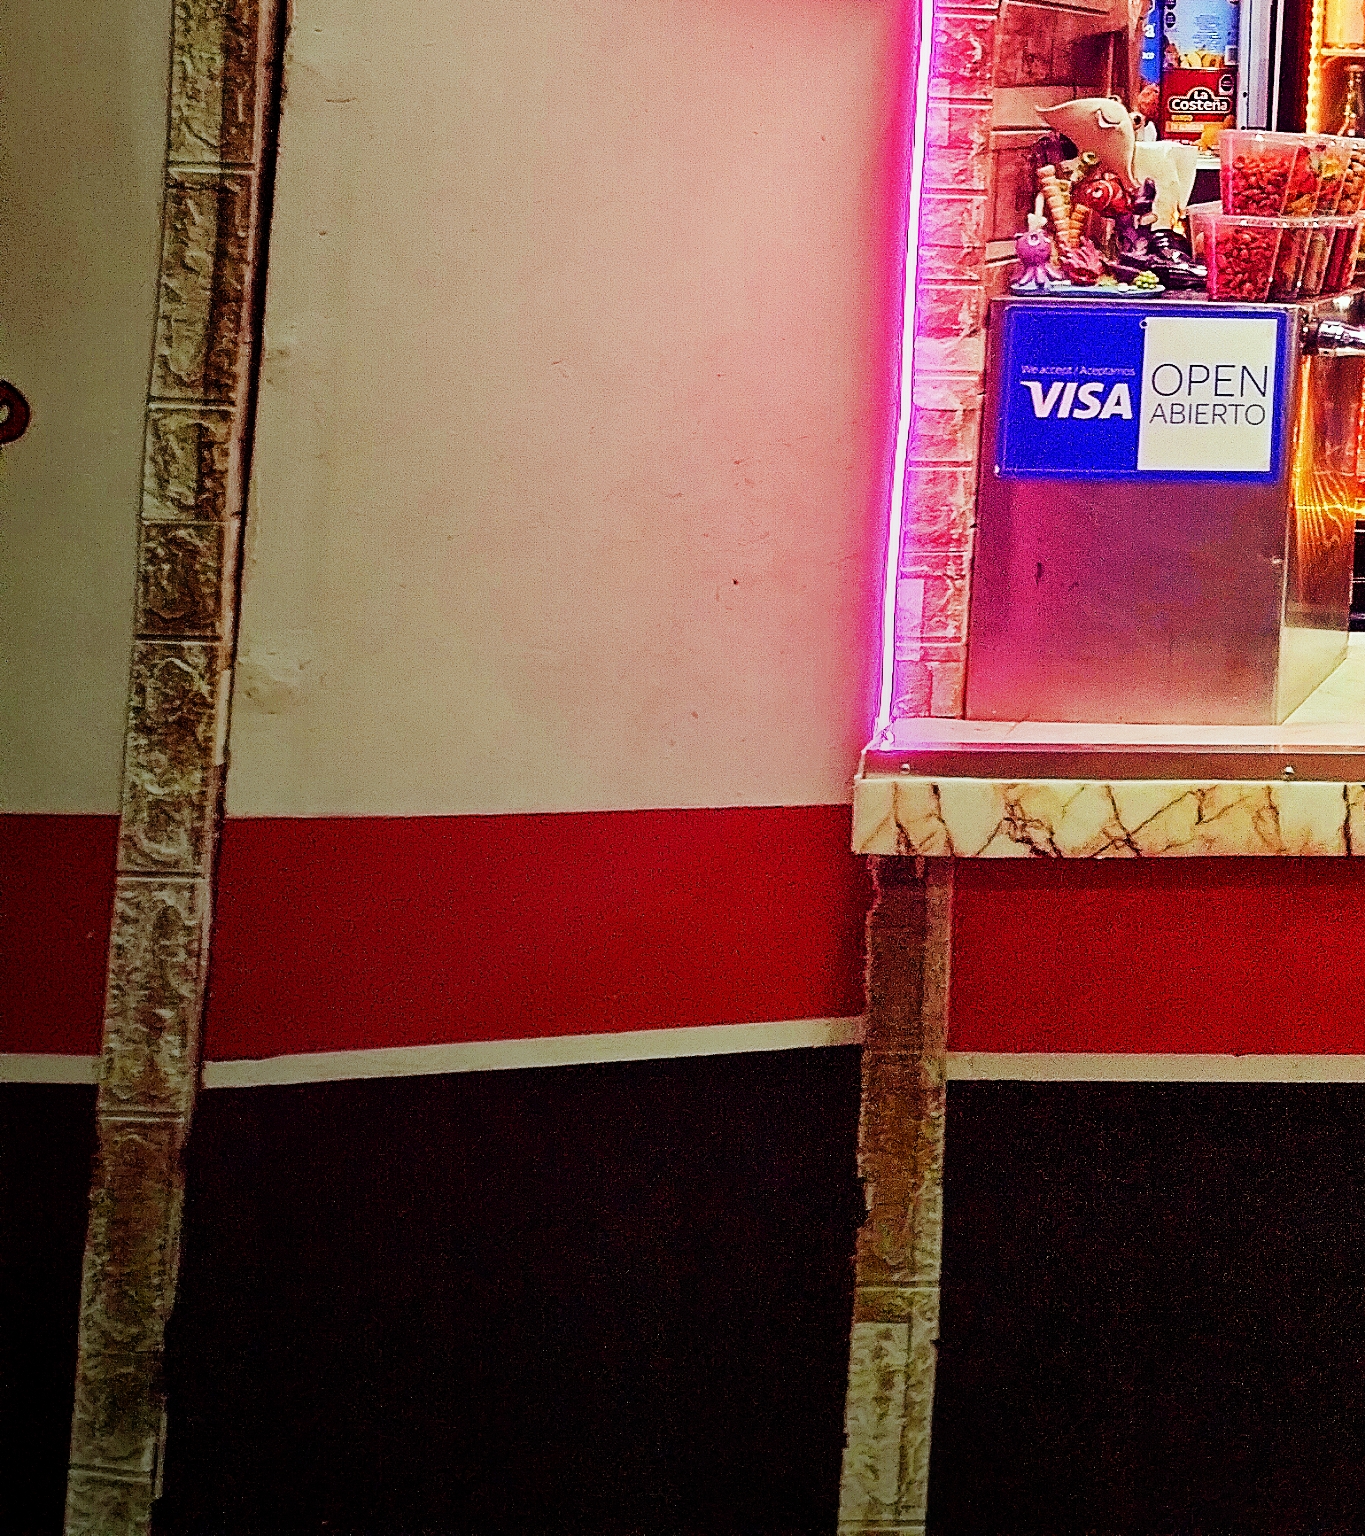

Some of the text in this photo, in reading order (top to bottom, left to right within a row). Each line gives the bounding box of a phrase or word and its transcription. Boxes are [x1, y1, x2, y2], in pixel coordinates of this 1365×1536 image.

[1171, 98, 1229, 112] Costeña
[1194, 90, 1208, 100] La
[1151, 363, 1268, 399] OPEN
[1020, 380, 1133, 420] VISA
[1149, 403, 1267, 426] ABIERTO
